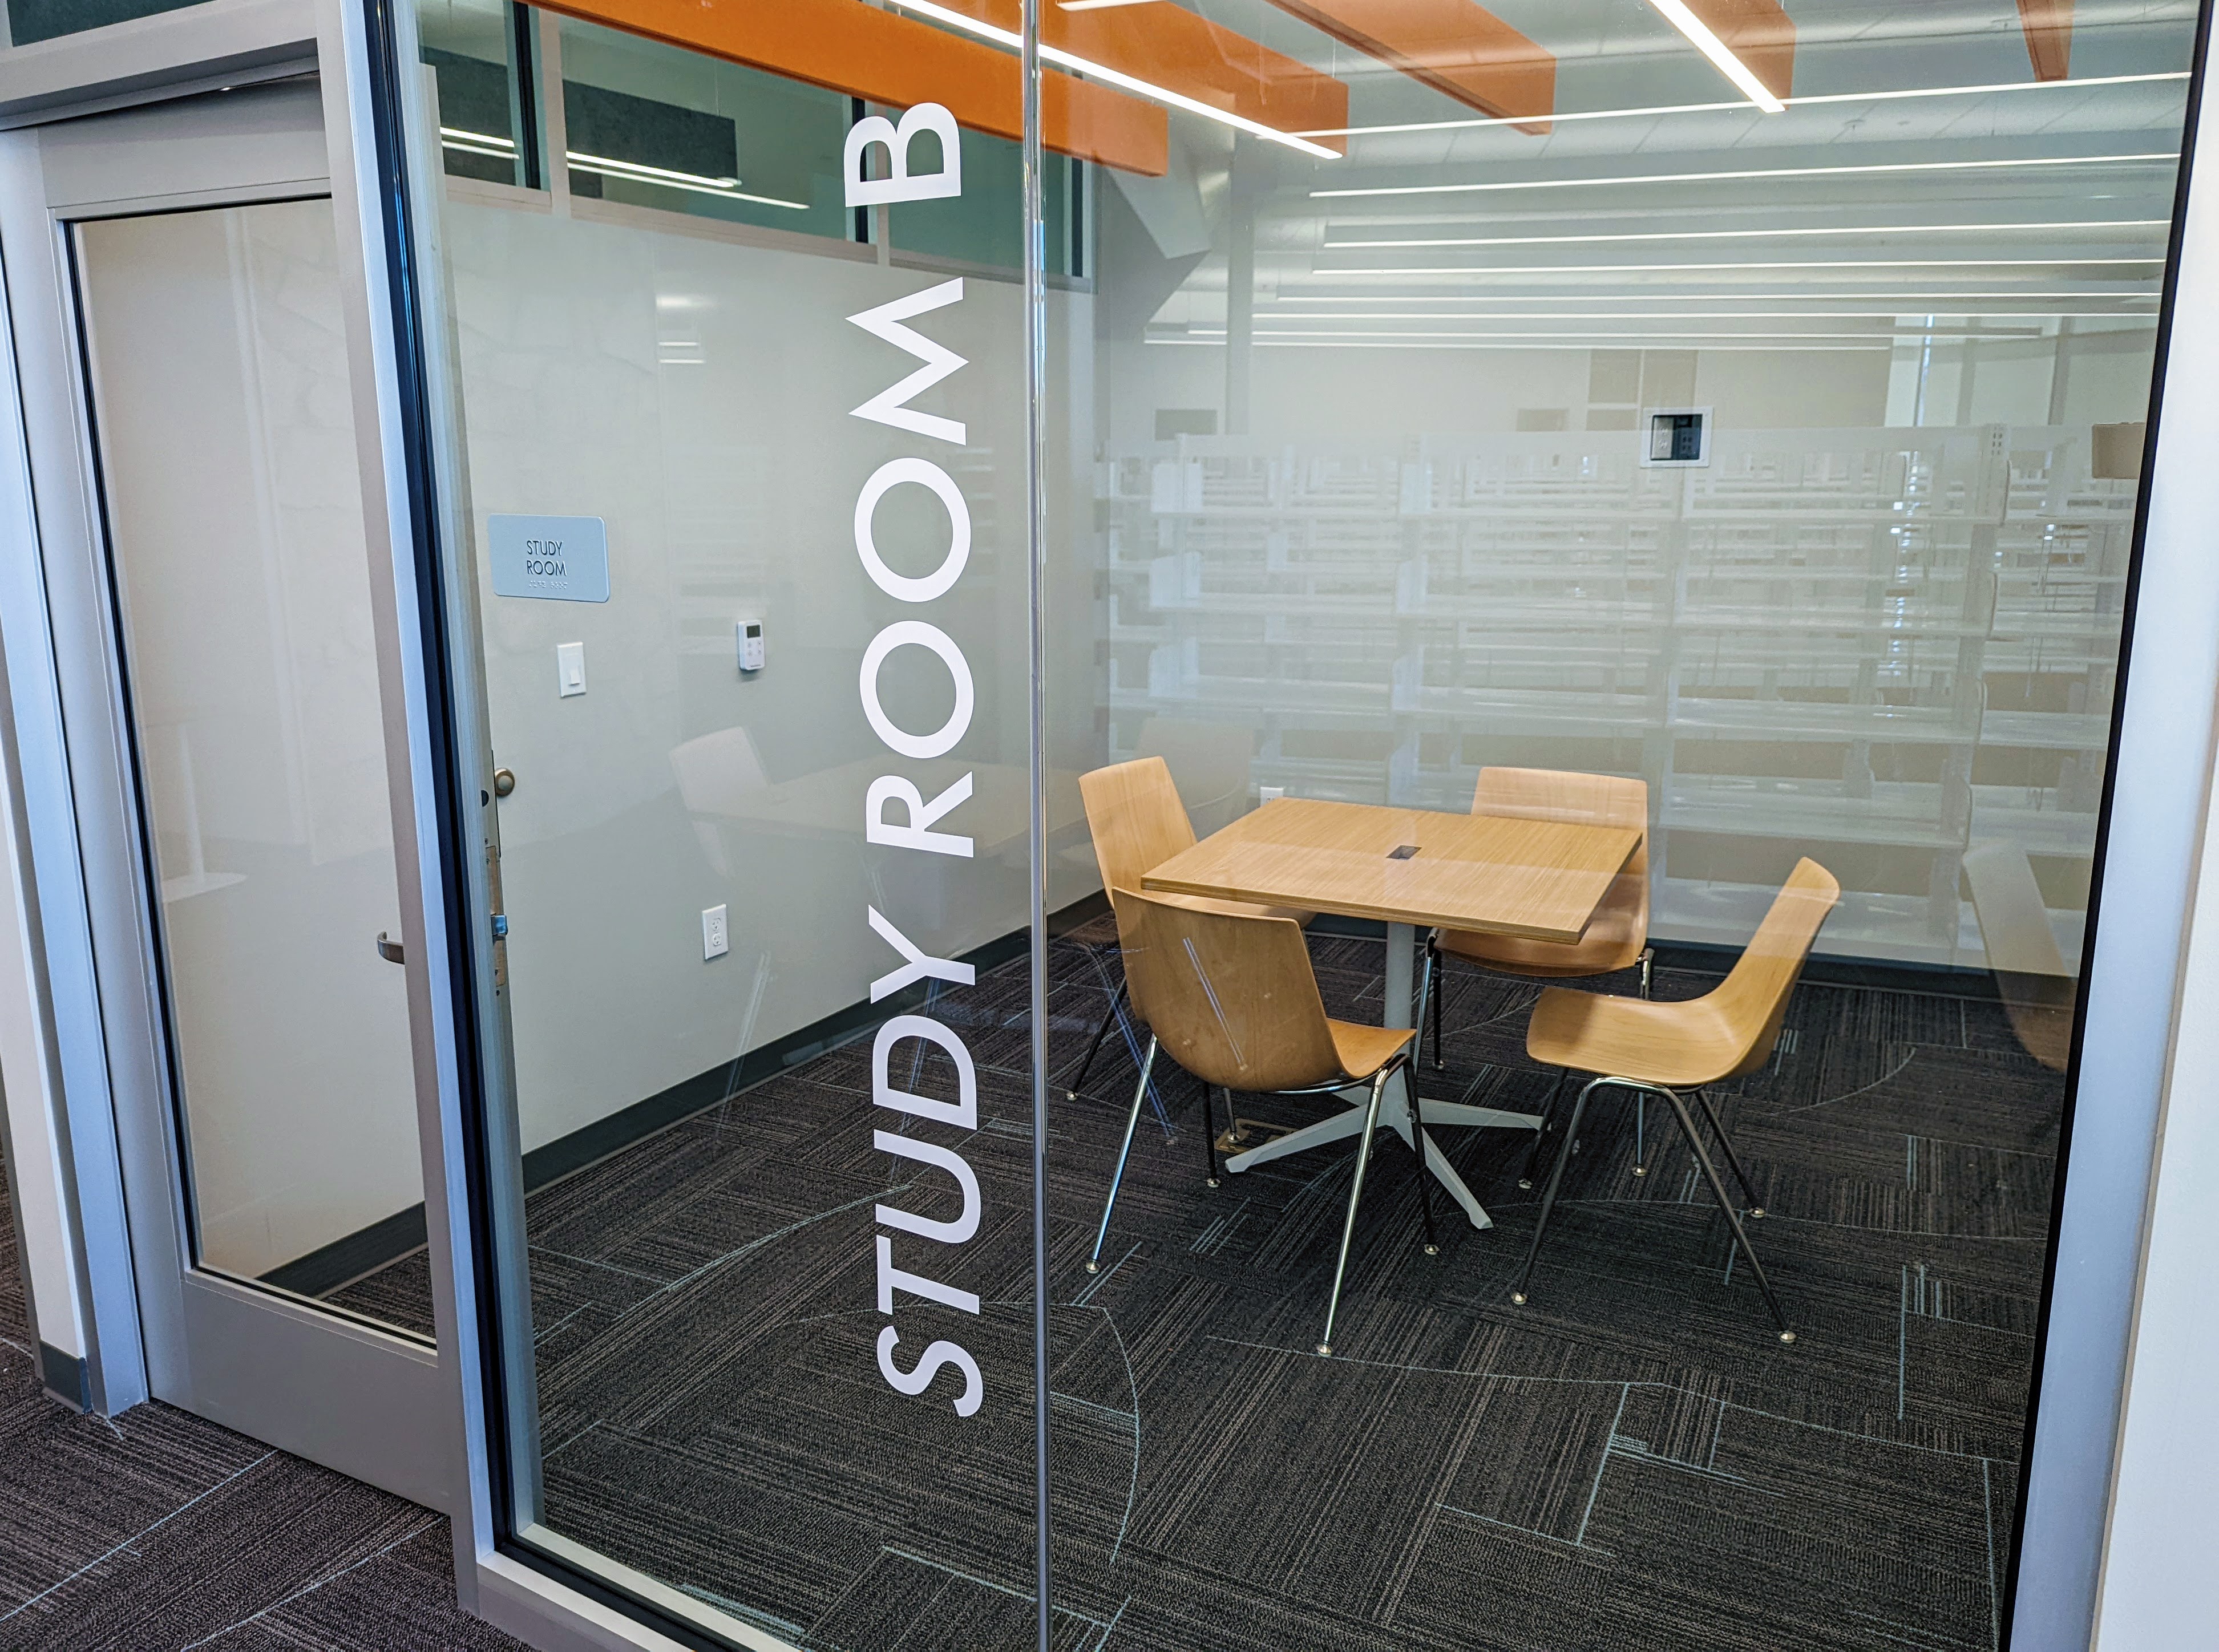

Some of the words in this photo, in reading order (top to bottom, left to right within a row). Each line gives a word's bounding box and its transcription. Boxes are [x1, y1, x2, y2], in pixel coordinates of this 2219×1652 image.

[843, 102, 962, 208] B
[526, 539, 563, 556] STUDY
[526, 559, 567, 576] ROOM
[844, 276, 975, 859] ROOM
[867, 904, 984, 1418] STUDY
